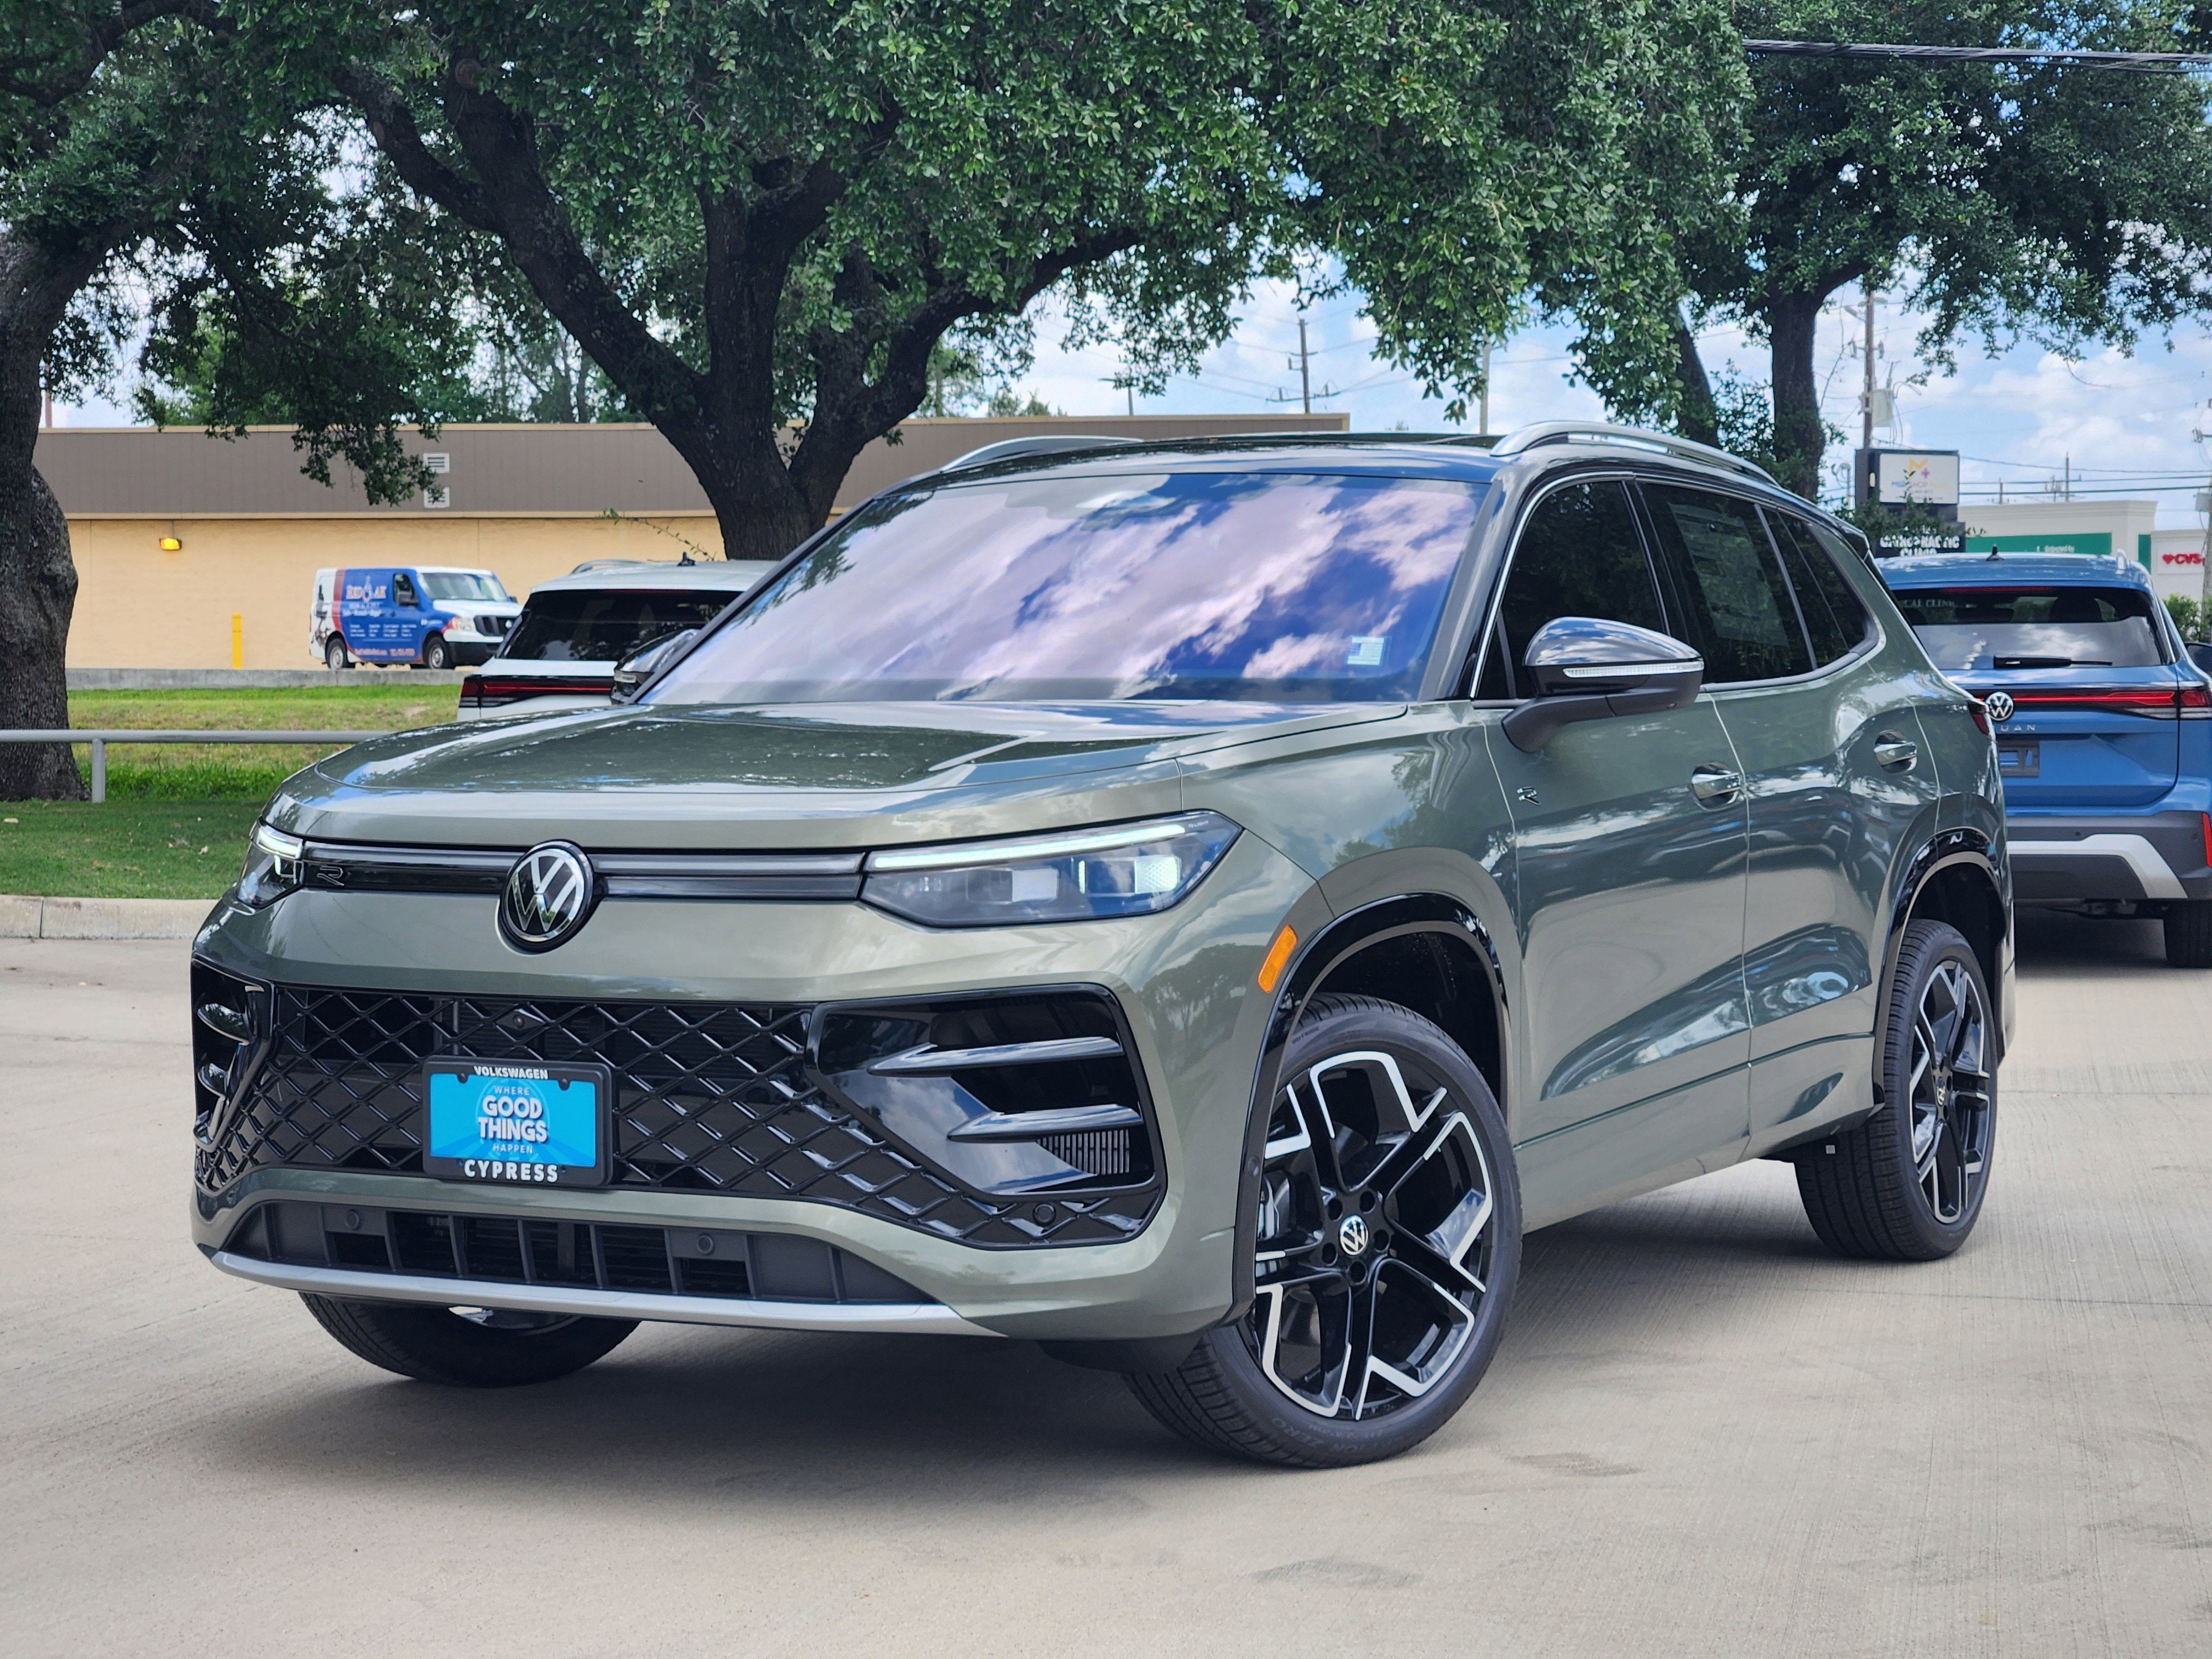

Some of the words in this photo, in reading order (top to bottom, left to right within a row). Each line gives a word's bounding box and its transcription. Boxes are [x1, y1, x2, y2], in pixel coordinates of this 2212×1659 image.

[1992, 724, 2036, 732] UAN
[316, 866, 345, 886] R
[473, 1066, 549, 1079] VOLKSWAGEN
[494, 1086, 530, 1095] WHERE
[482, 1095, 543, 1119] GOOD
[477, 1117, 549, 1143] THINGS
[493, 1144, 533, 1154] HAPPEN
[464, 1160, 559, 1183] CYPRESS
